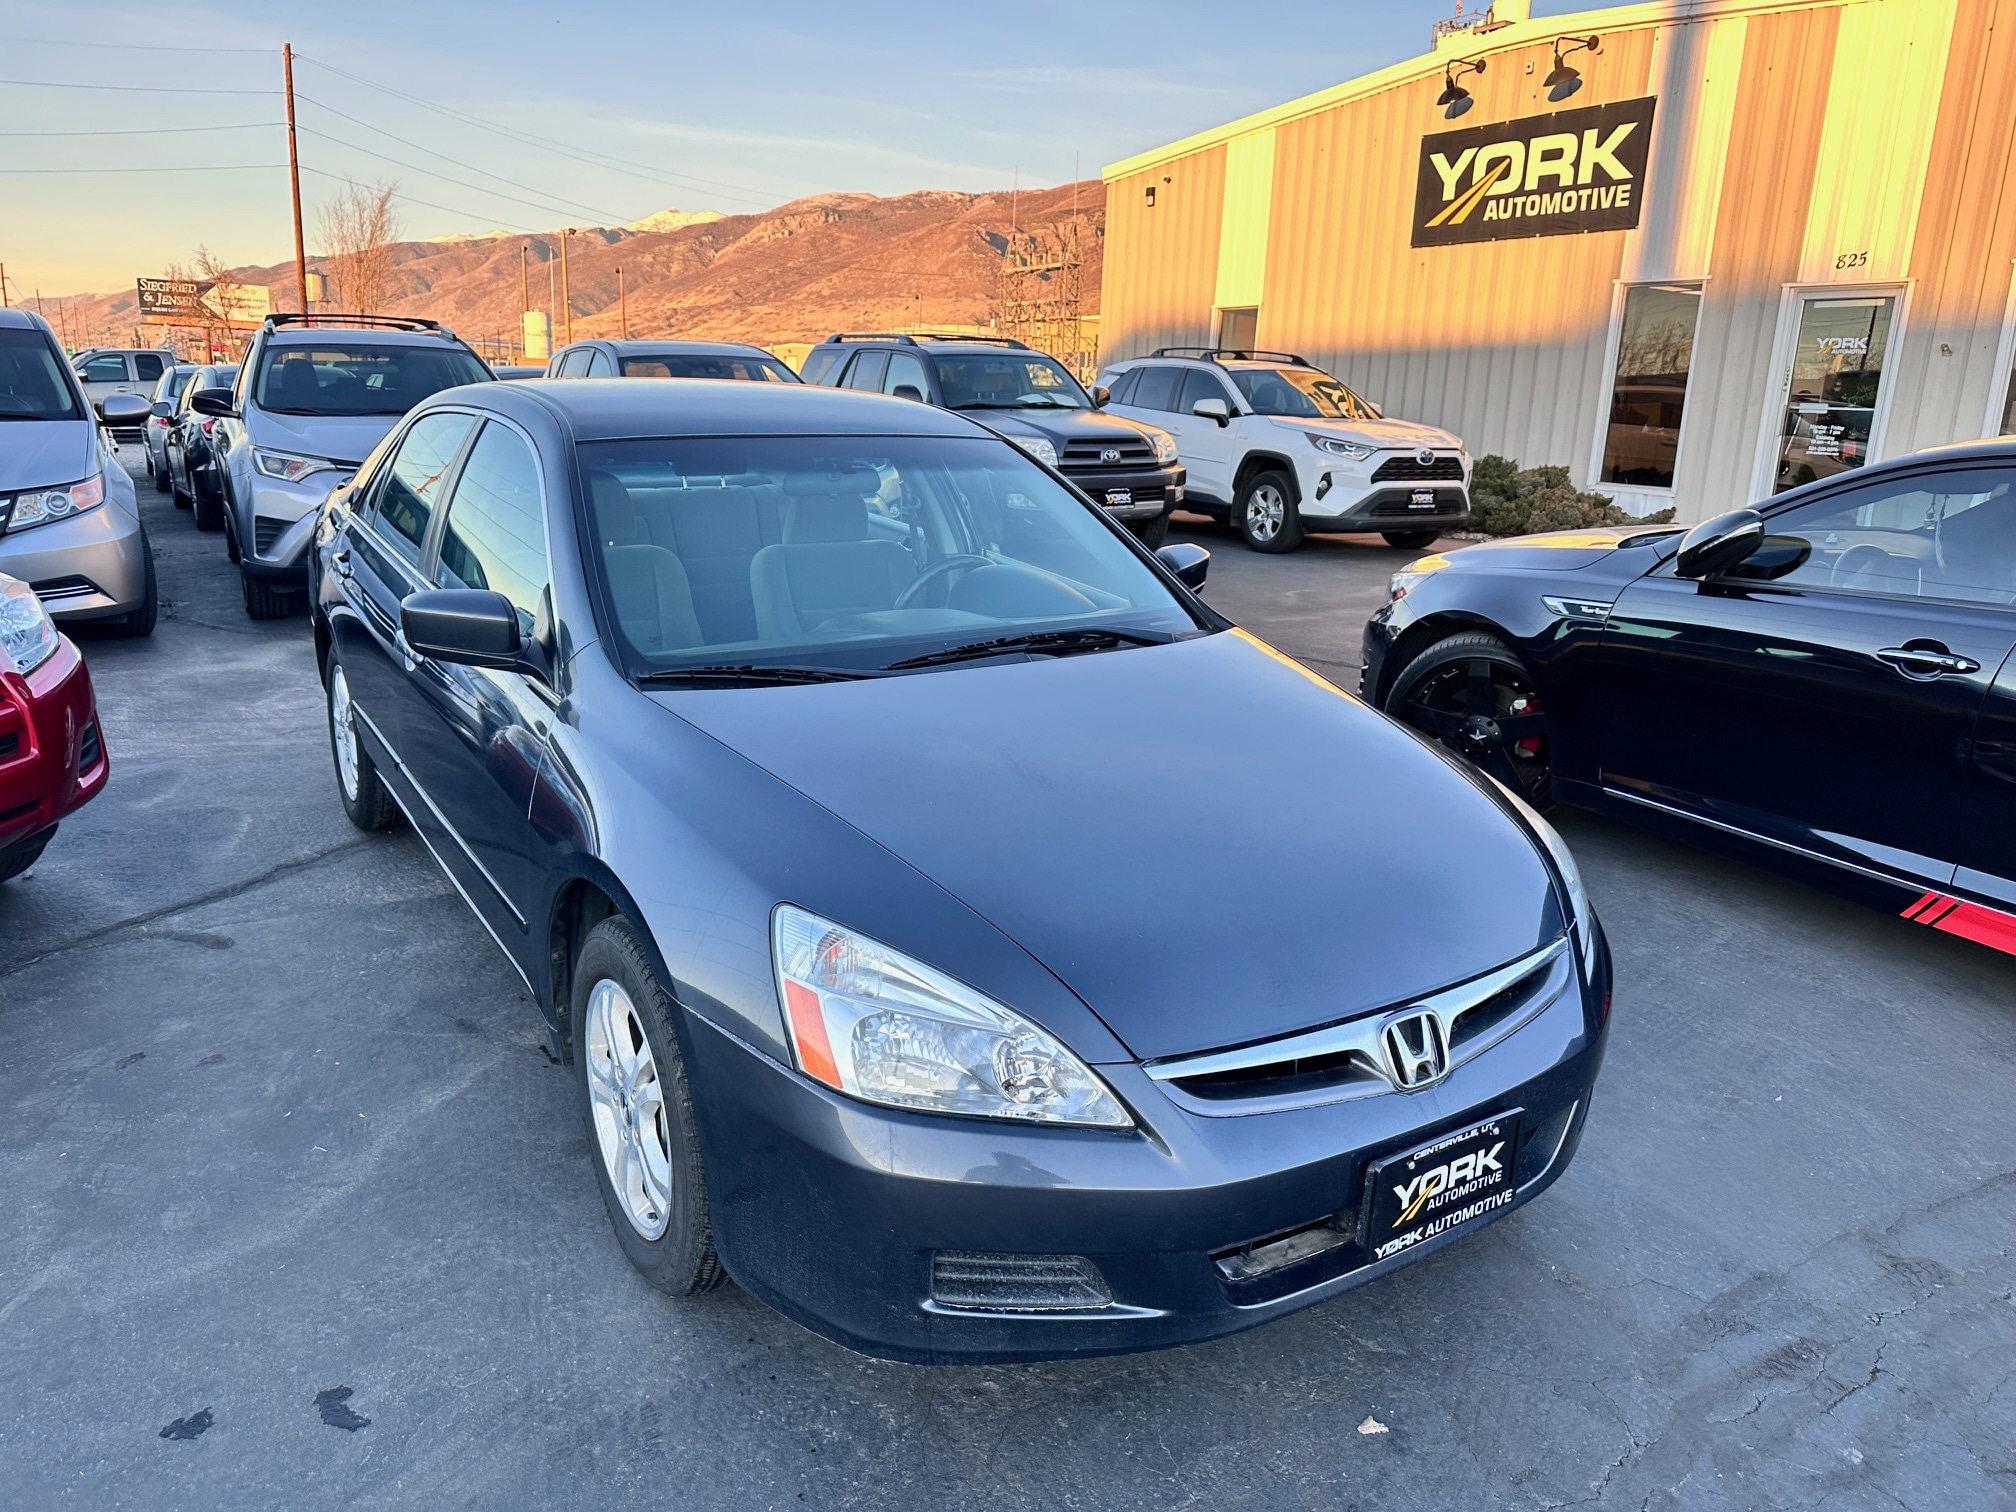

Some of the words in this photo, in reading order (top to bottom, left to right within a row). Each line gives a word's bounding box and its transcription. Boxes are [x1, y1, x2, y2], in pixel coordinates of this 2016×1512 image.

[1429, 122, 1639, 202] YORK
[1483, 184, 1632, 222] AUTOMOTIVE
[1836, 251, 1868, 269] 825
[139, 278, 198, 294] SIEGFRIED
[143, 291, 155, 302] &
[1816, 337, 1869, 349] YORK
[1413, 1130, 1479, 1161] CENTERVILLE,
[1481, 1122, 1496, 1134] UT
[1393, 1141, 1506, 1211] YORK
[1426, 1170, 1503, 1211] AUTOMOTIVE
[1374, 1226, 1424, 1259] YORK
[1425, 1189, 1514, 1238] AUTOMOTIVE
